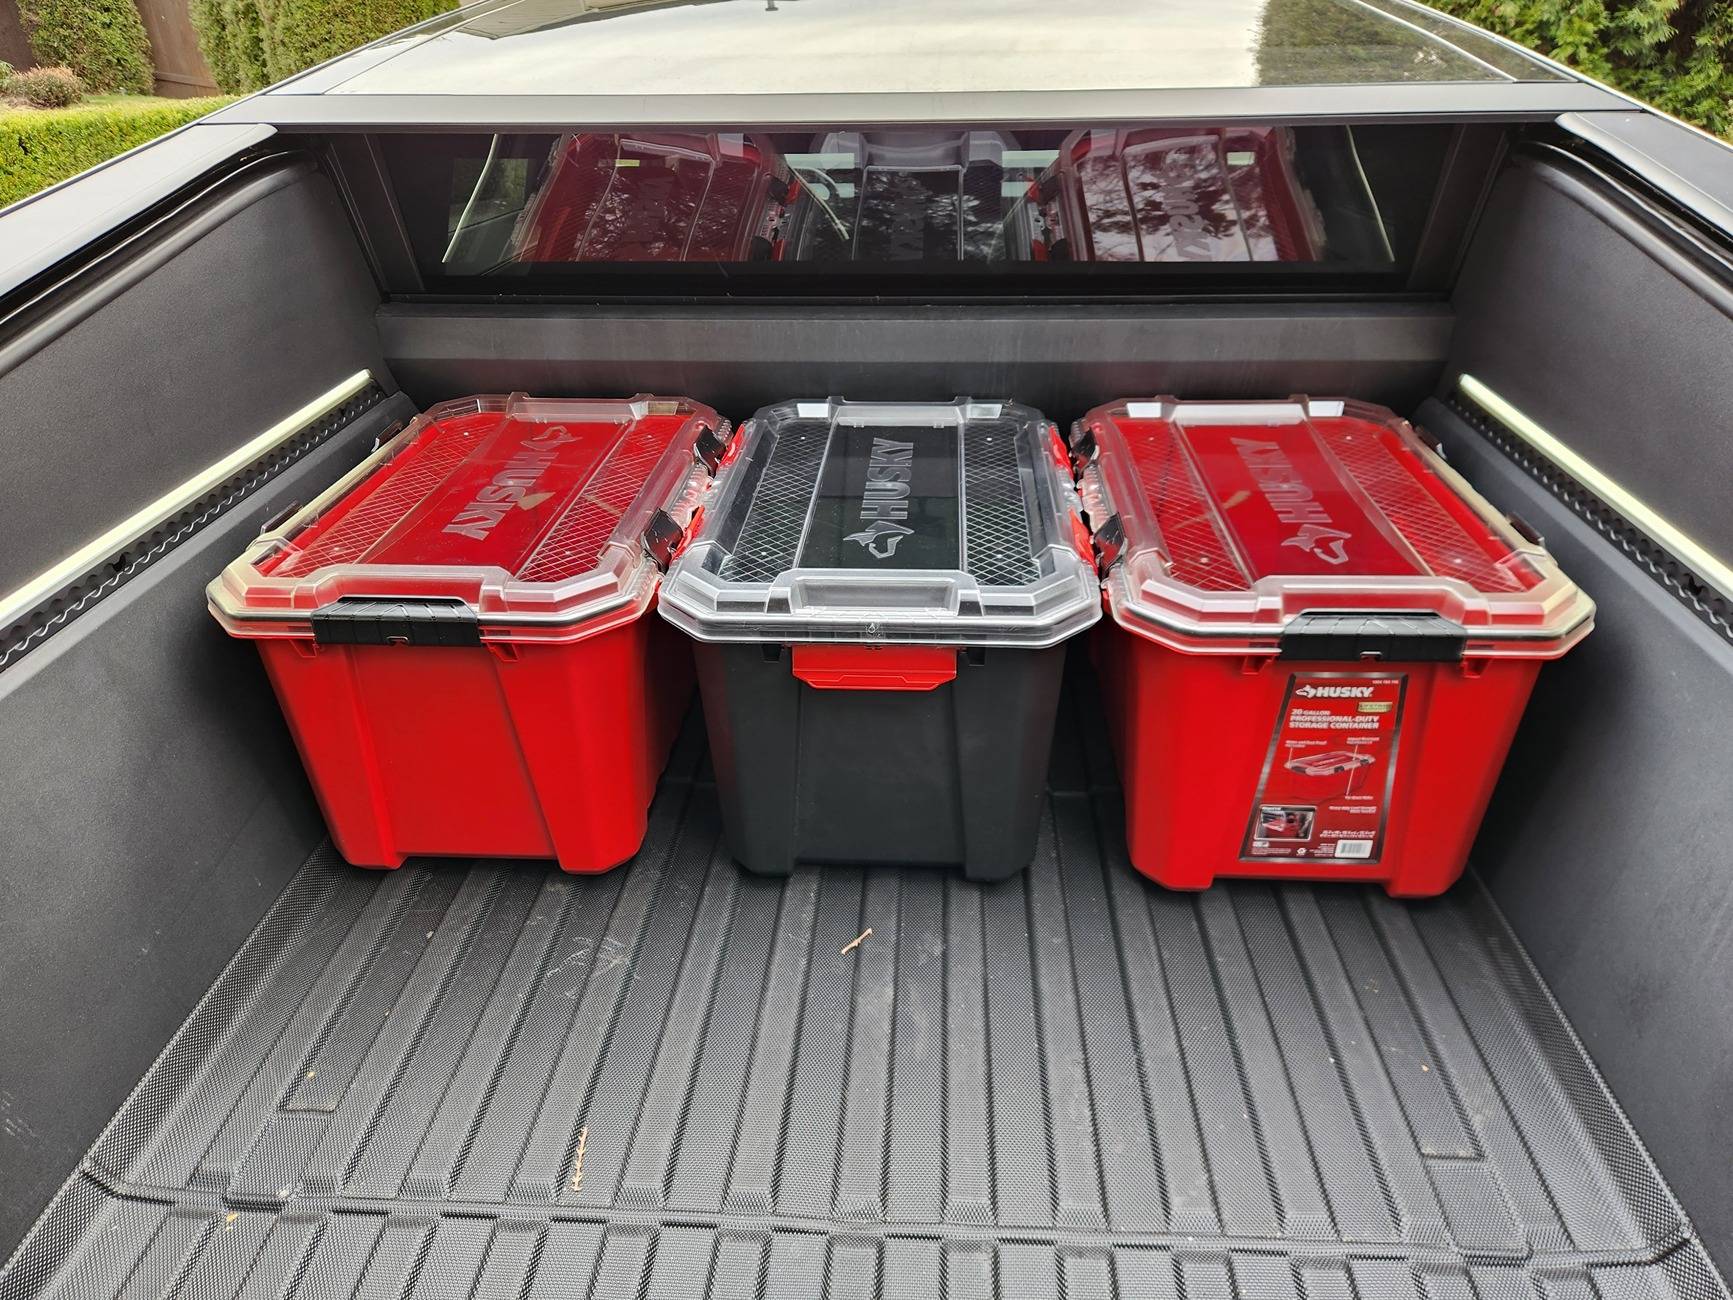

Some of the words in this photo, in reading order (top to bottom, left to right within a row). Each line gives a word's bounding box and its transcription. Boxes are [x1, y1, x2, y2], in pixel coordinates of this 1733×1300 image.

[442, 452, 559, 541] HUSKY
[860, 437, 914, 520] HUSKY
[1230, 437, 1333, 523] HUSKY
[1316, 686, 1374, 698] HUSKY
